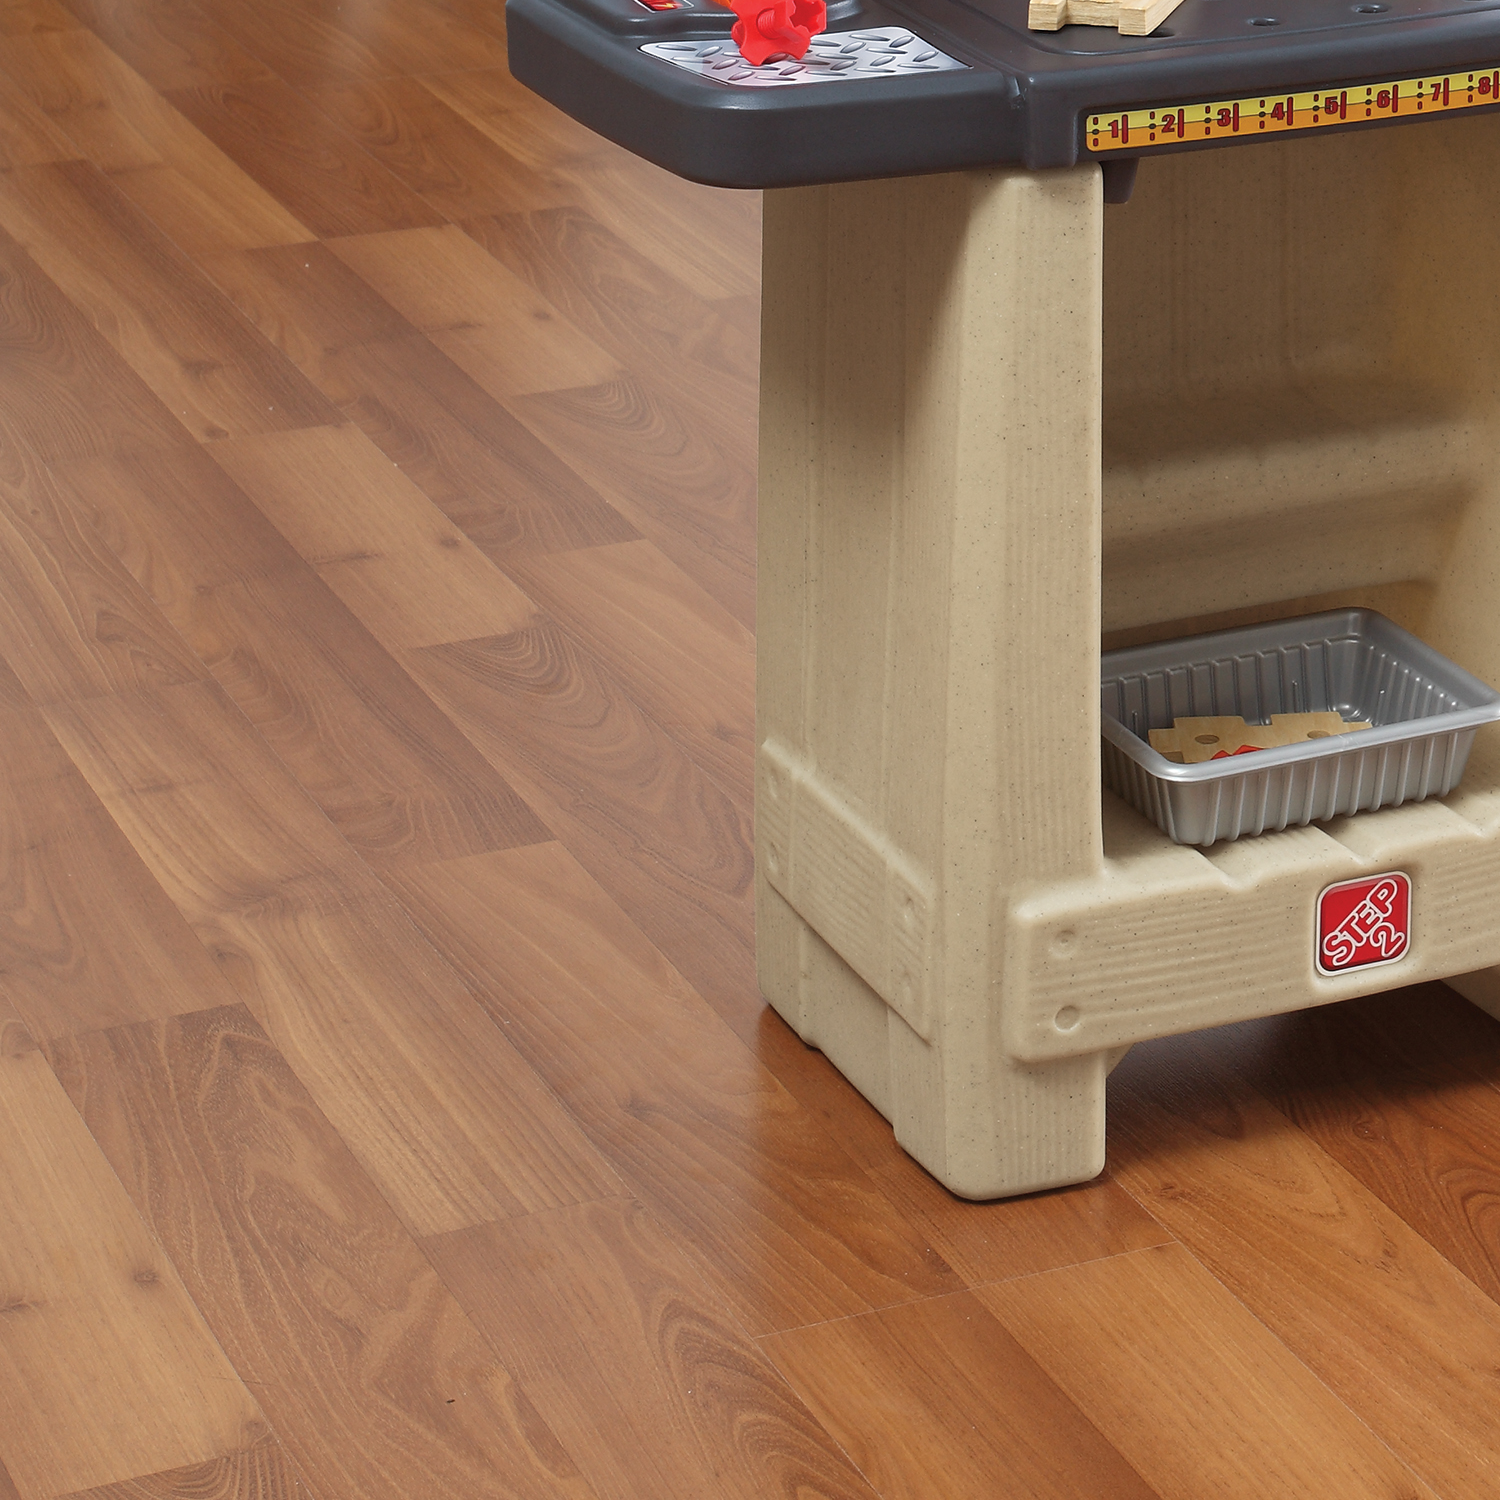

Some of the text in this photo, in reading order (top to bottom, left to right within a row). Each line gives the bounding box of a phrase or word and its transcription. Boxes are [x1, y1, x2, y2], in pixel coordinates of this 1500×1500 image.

[1108, 119, 1119, 138] 1
[1161, 114, 1175, 133] 2
[1217, 108, 1231, 127] 3
[1270, 102, 1285, 121] 4
[1324, 96, 1339, 115] 5
[1377, 90, 1391, 109] 6
[1430, 82, 1441, 101] 7
[1478, 76, 1491, 95] 8
[1322, 878, 1398, 967] STEP
[1370, 922, 1405, 958] 2
